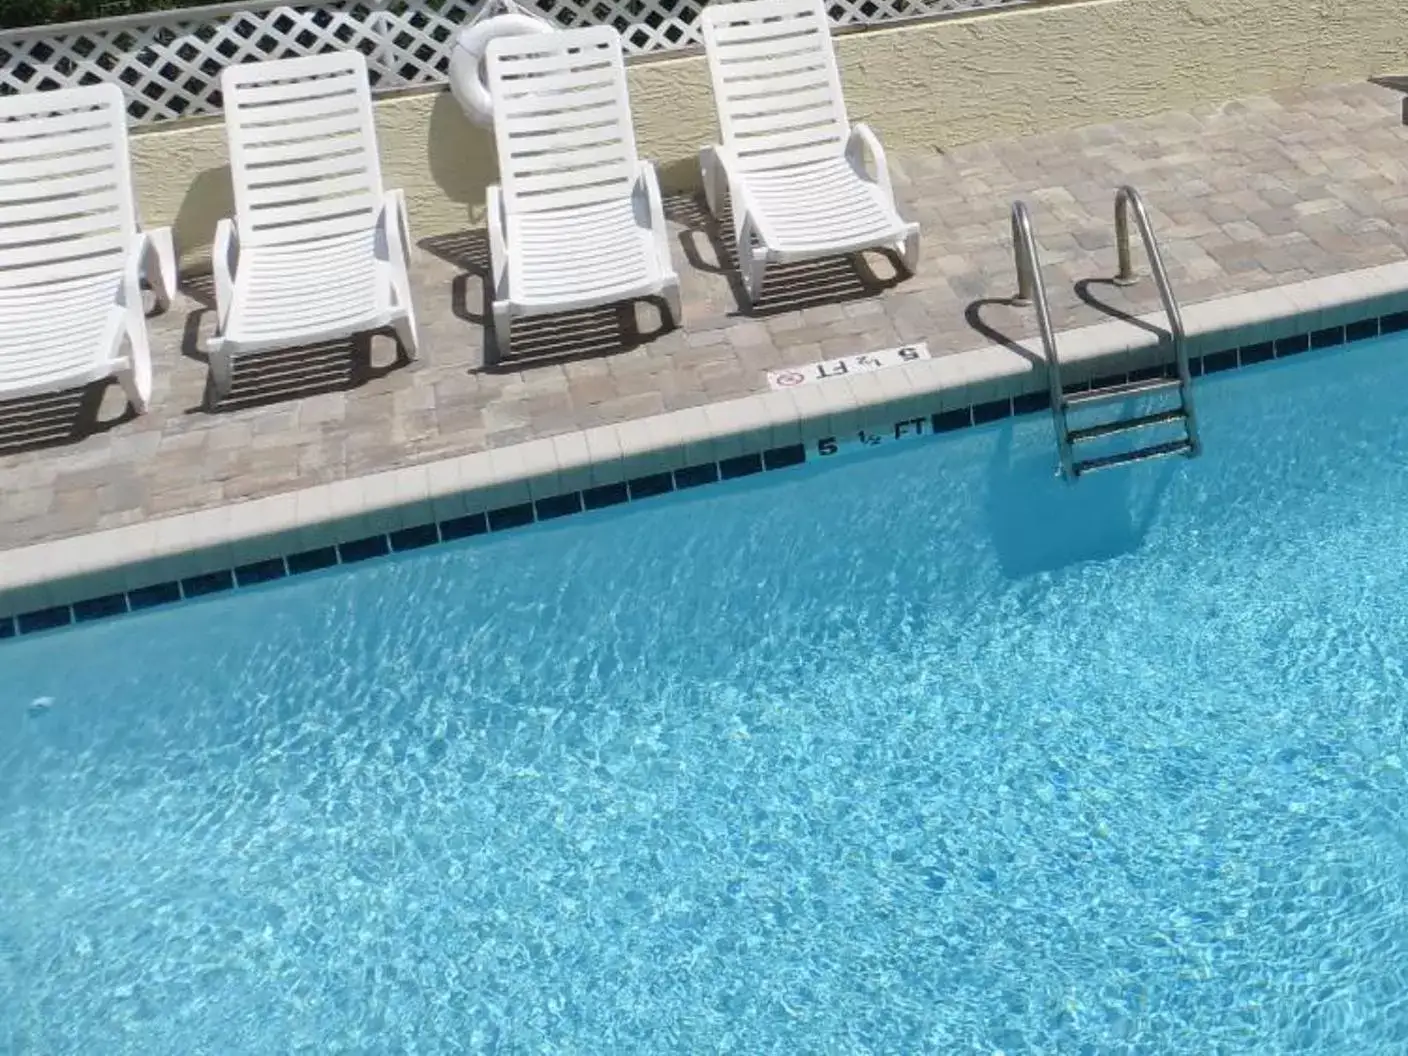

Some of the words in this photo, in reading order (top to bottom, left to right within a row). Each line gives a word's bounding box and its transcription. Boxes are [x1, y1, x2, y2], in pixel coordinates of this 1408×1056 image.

[898, 347, 920, 361] 5
[815, 361, 849, 379] FT
[818, 436, 838, 455] 5
[894, 417, 926, 440] FT
